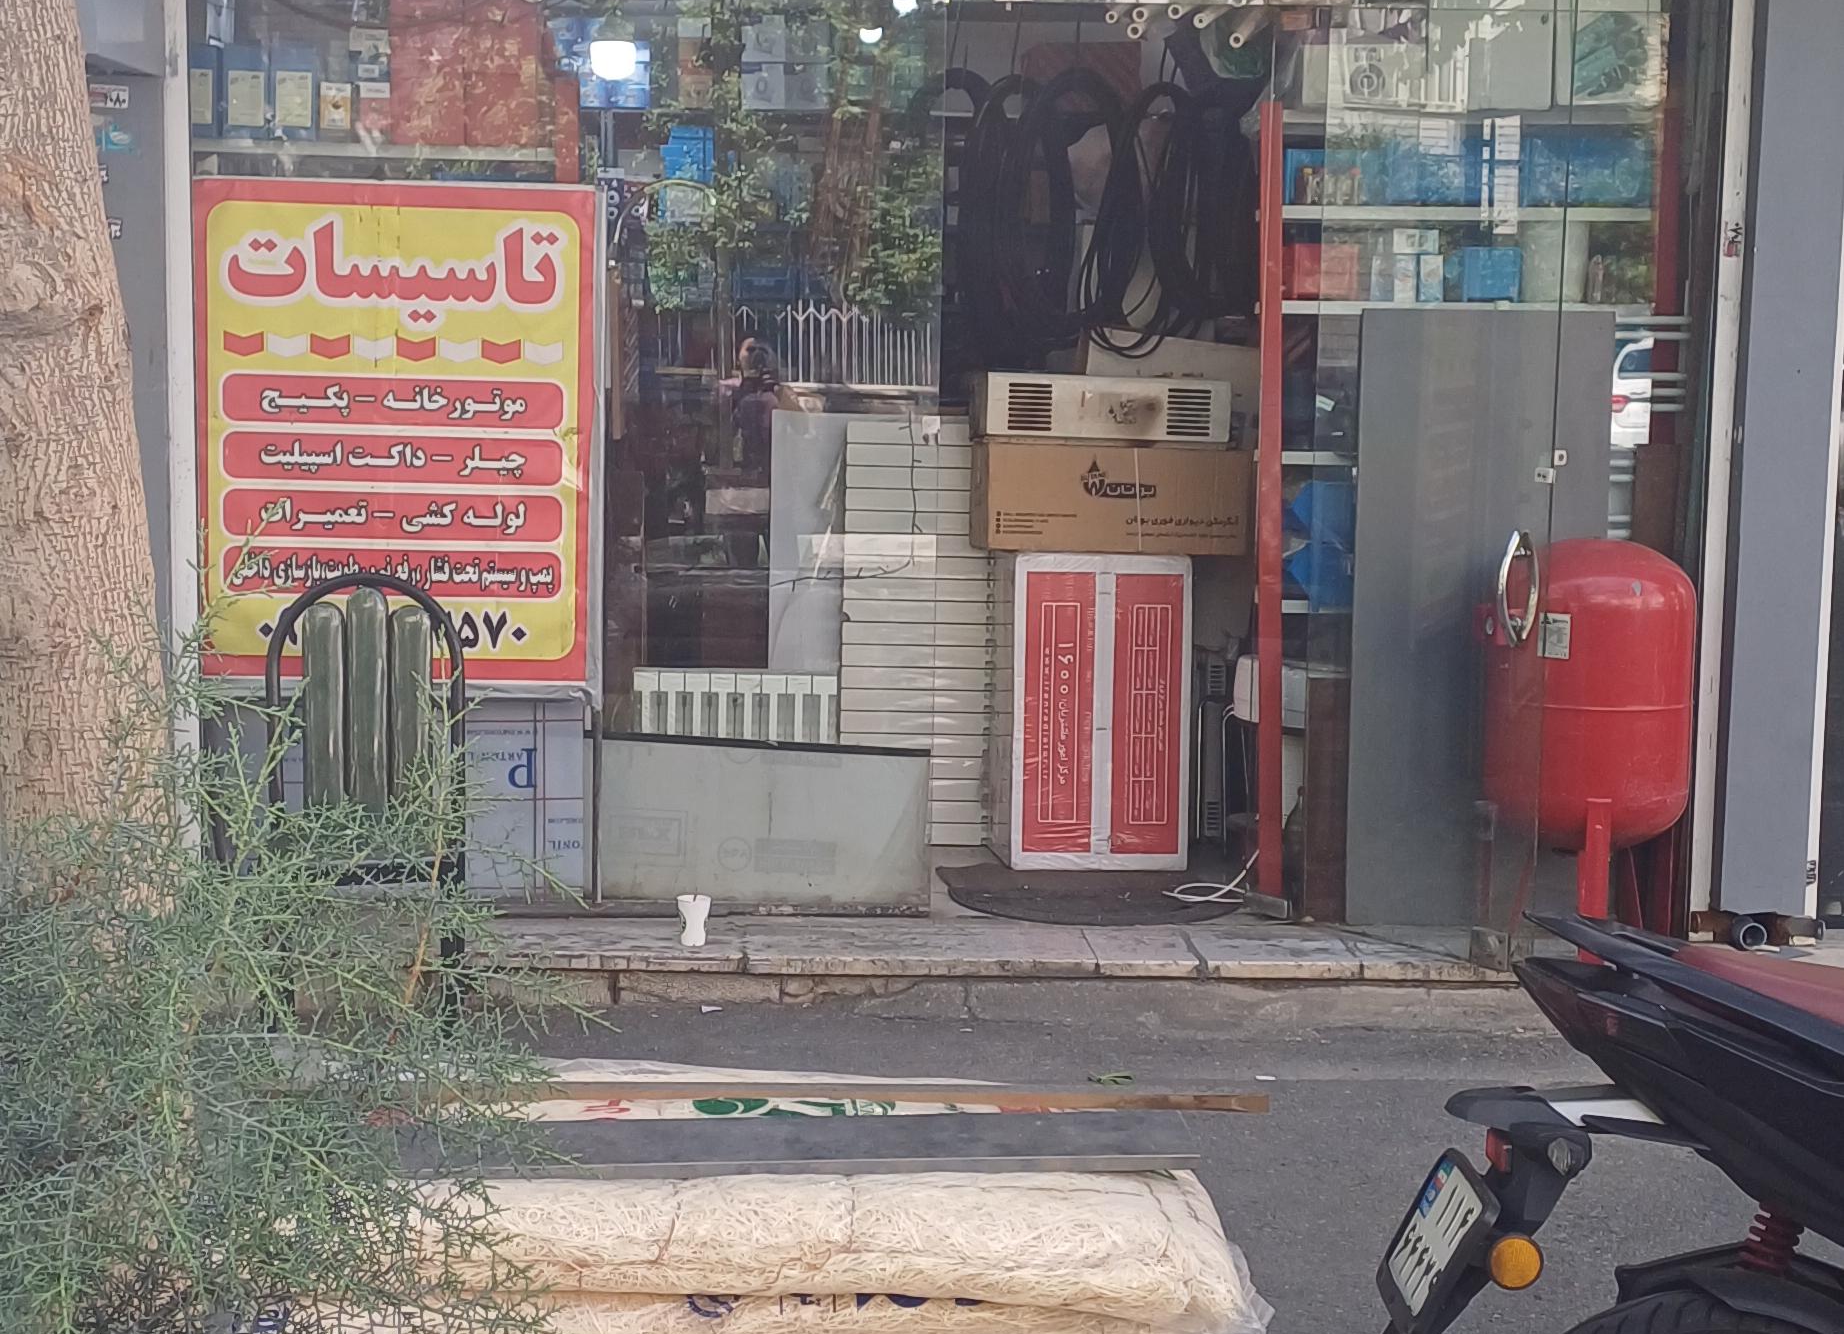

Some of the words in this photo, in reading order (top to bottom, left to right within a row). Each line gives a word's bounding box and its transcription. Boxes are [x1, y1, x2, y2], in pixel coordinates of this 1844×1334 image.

[227, 220, 560, 324] تاسیسات
[260, 382, 350, 418] پکیج
[259, 438, 344, 474] اسپیلیت
[348, 441, 428, 468] داکت
[458, 443, 527, 478] چیلر
[258, 495, 369, 531] تعمیرات
[400, 501, 457, 534] کشی
[461, 501, 527, 535] لوله
[422, 555, 451, 591] فشار
[452, 556, 481, 584] تحت
[480, 559, 518, 592] سیستم
[517, 566, 527, 593] و
[528, 565, 555, 594] پمپ
[546, 840, 583, 851] ONIL
